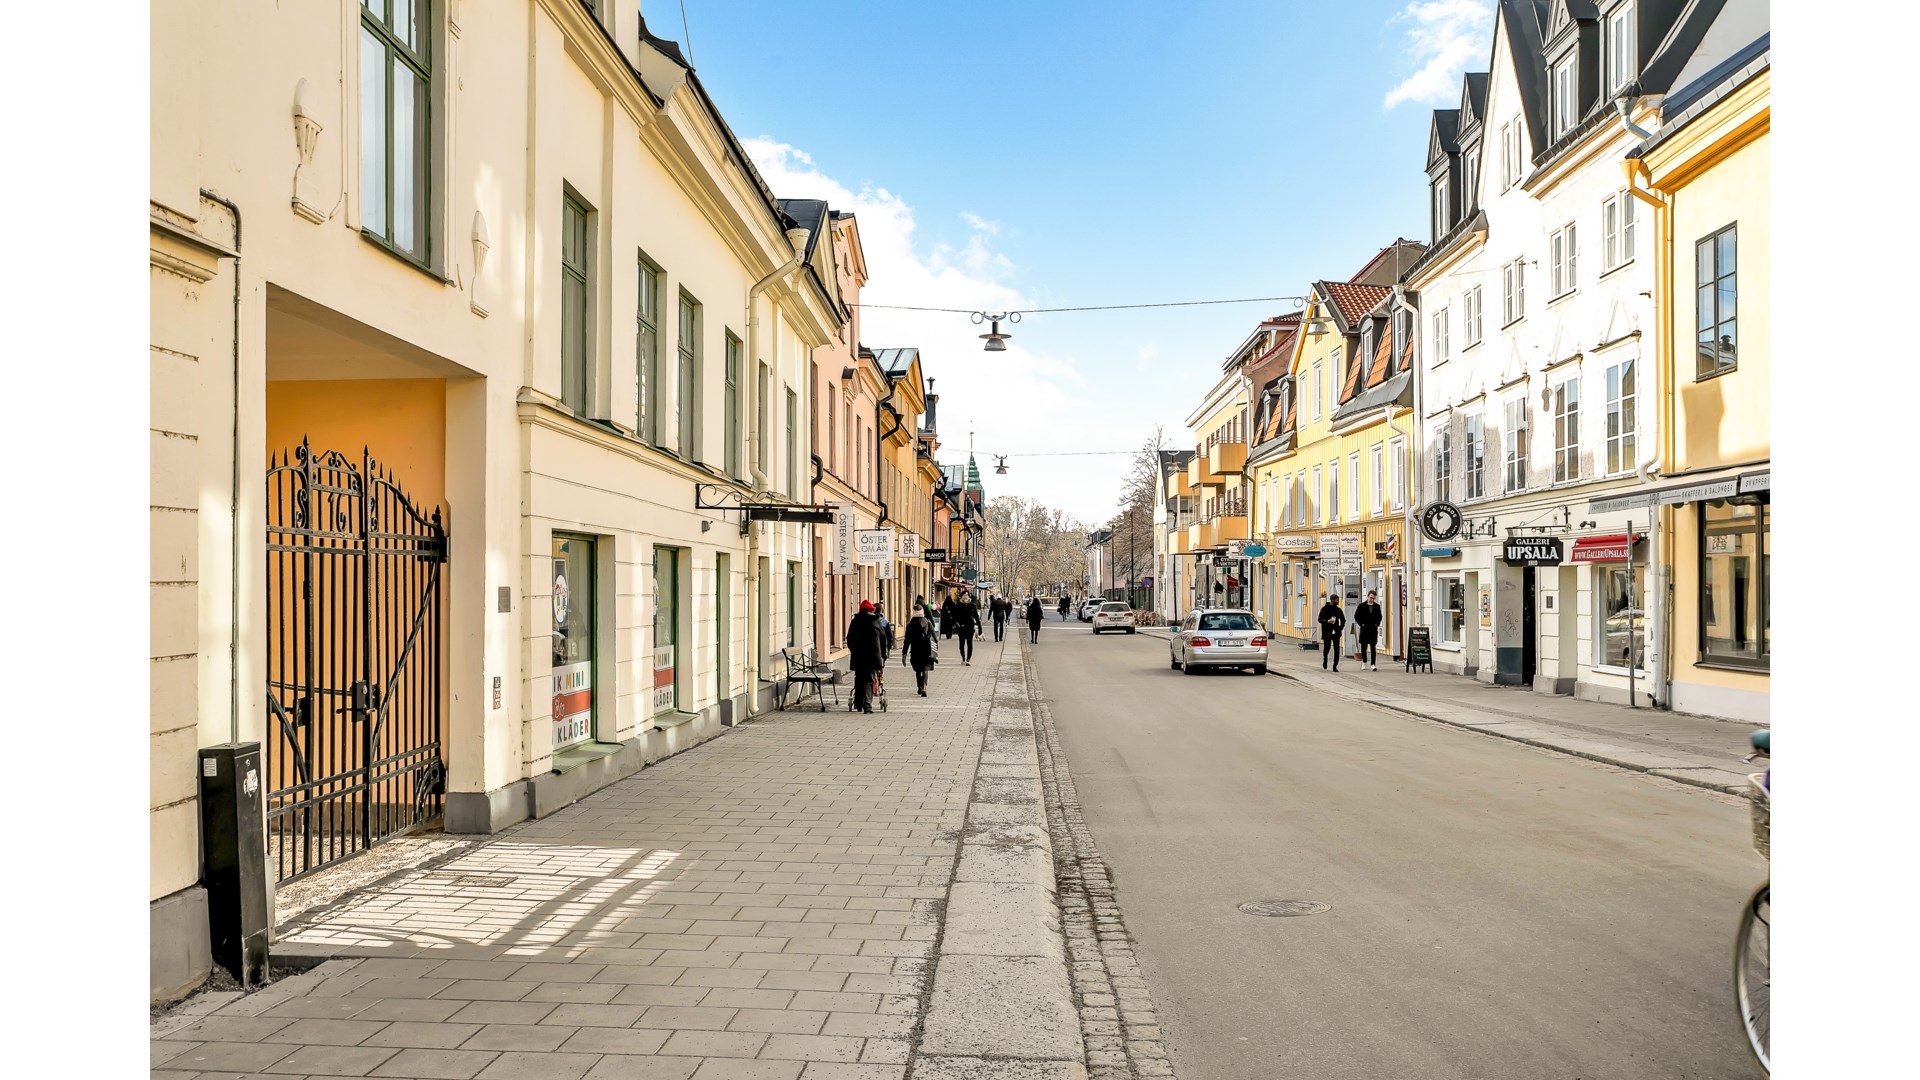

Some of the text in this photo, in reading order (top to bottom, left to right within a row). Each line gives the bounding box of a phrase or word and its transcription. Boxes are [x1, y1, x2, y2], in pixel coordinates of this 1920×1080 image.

[1681, 489, 1703, 498] SKAFFERI
[1709, 484, 1733, 495] SALONGER
[1426, 507, 1437, 519] LOS
[839, 513, 849, 569] ÖSTER OM ÅN
[860, 534, 888, 544] ÖSTER
[1277, 537, 1311, 546] Costas
[861, 541, 888, 553] OM ÅN
[1507, 546, 1559, 560] UPSALA
[657, 652, 670, 667] MINI
[553, 670, 584, 692] IK MINI
[557, 717, 589, 744] KLÄDER
